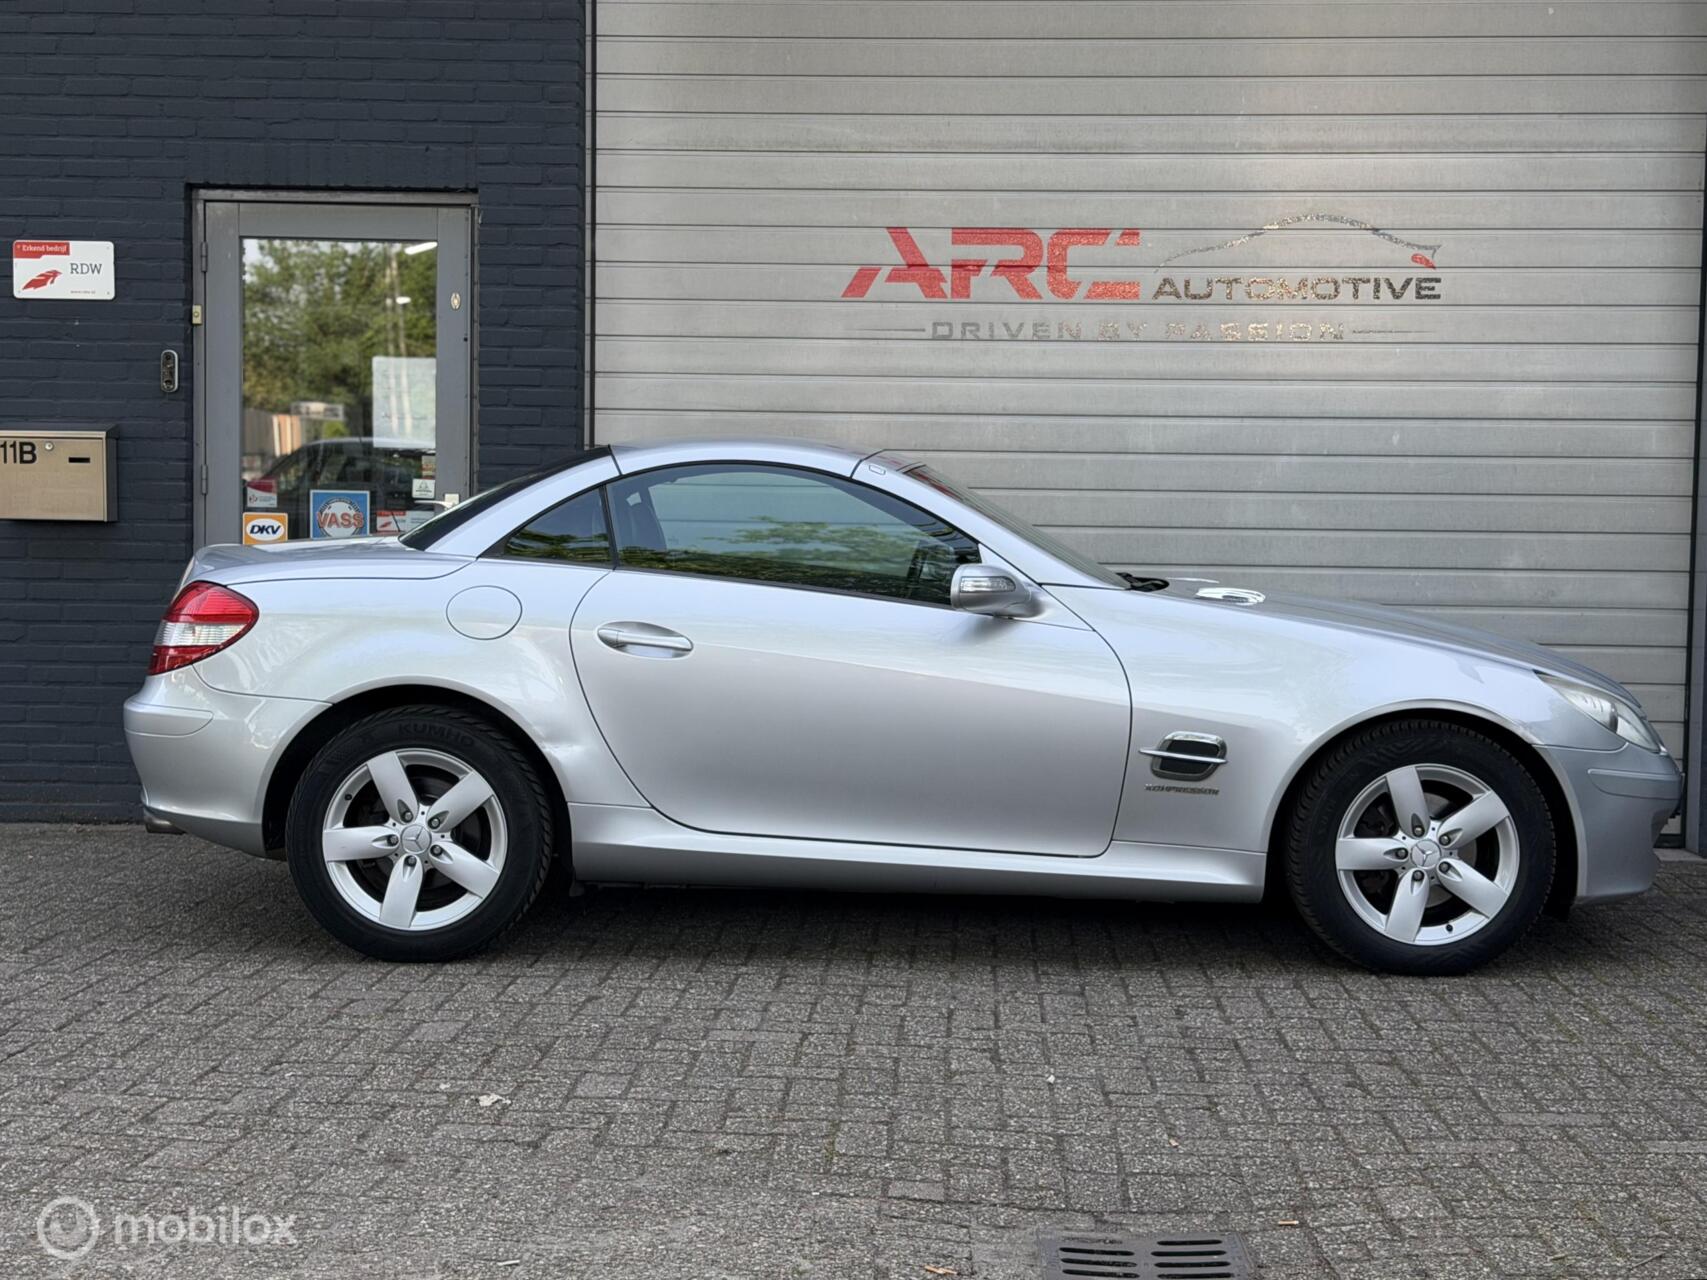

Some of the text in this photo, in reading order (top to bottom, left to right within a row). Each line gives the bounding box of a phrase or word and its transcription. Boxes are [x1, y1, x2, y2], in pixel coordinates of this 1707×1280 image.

[22, 244, 67, 254] Erkend bedrijf
[70, 263, 102, 275] RDW
[840, 227, 1141, 299] ARC
[1153, 276, 1442, 300] AUTOMOTIVE
[932, 321, 1345, 341] DRIVEN BY PASSION
[0, 441, 37, 464] 11B
[249, 525, 281, 535] DKV
[317, 512, 364, 528] VASS
[397, 722, 475, 747] KUMHO
